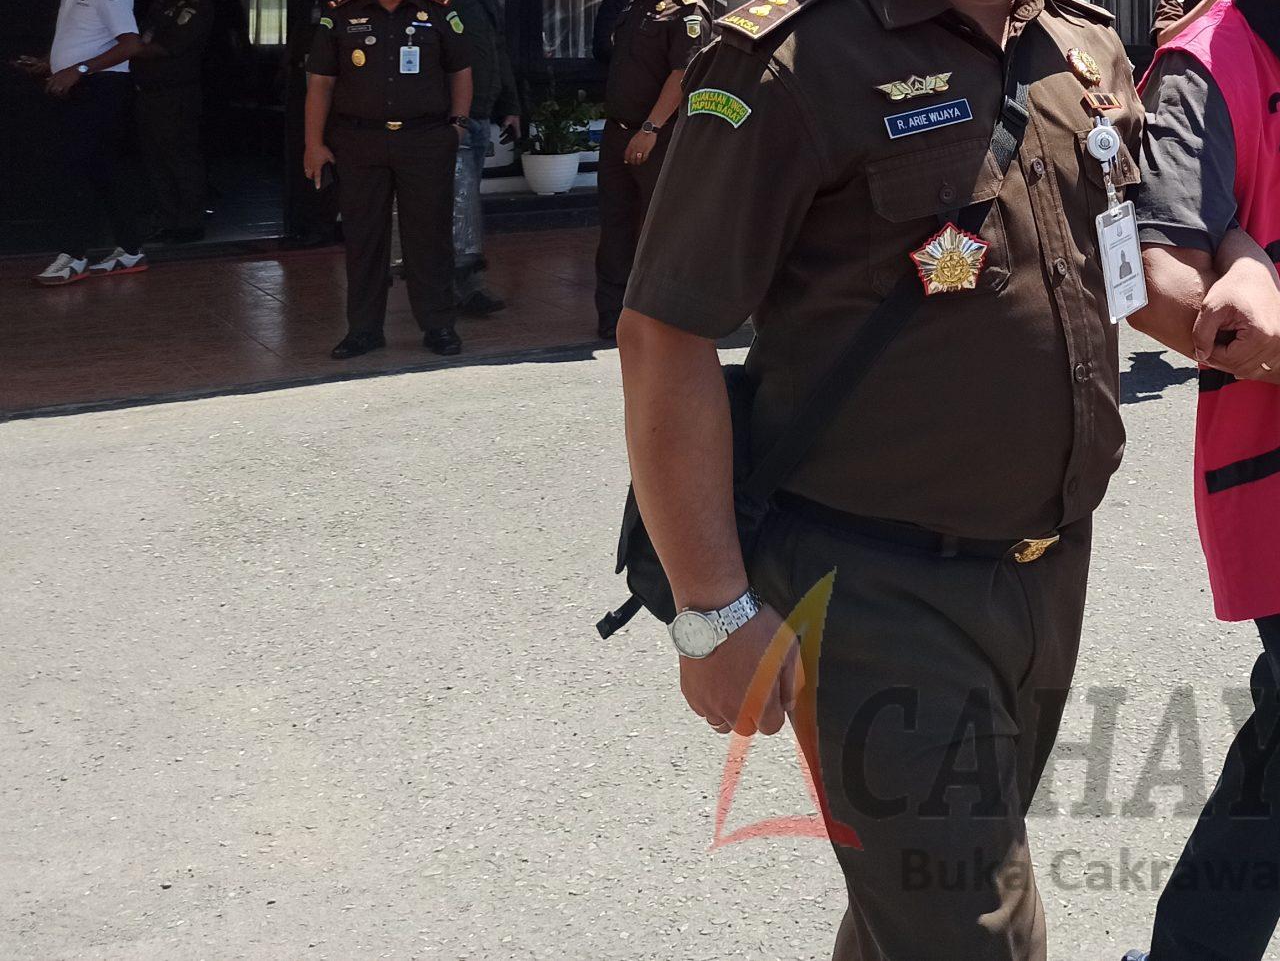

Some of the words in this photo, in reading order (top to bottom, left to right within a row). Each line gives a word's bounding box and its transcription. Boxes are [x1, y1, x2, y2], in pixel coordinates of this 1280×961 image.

[725, 15, 759, 34] JAKSA
[690, 101, 716, 112] PAPUA
[716, 103, 741, 123] BARAT
[897, 119, 907, 130] R.
[909, 114, 928, 128] ARIE
[928, 106, 961, 123] WIJAYA
